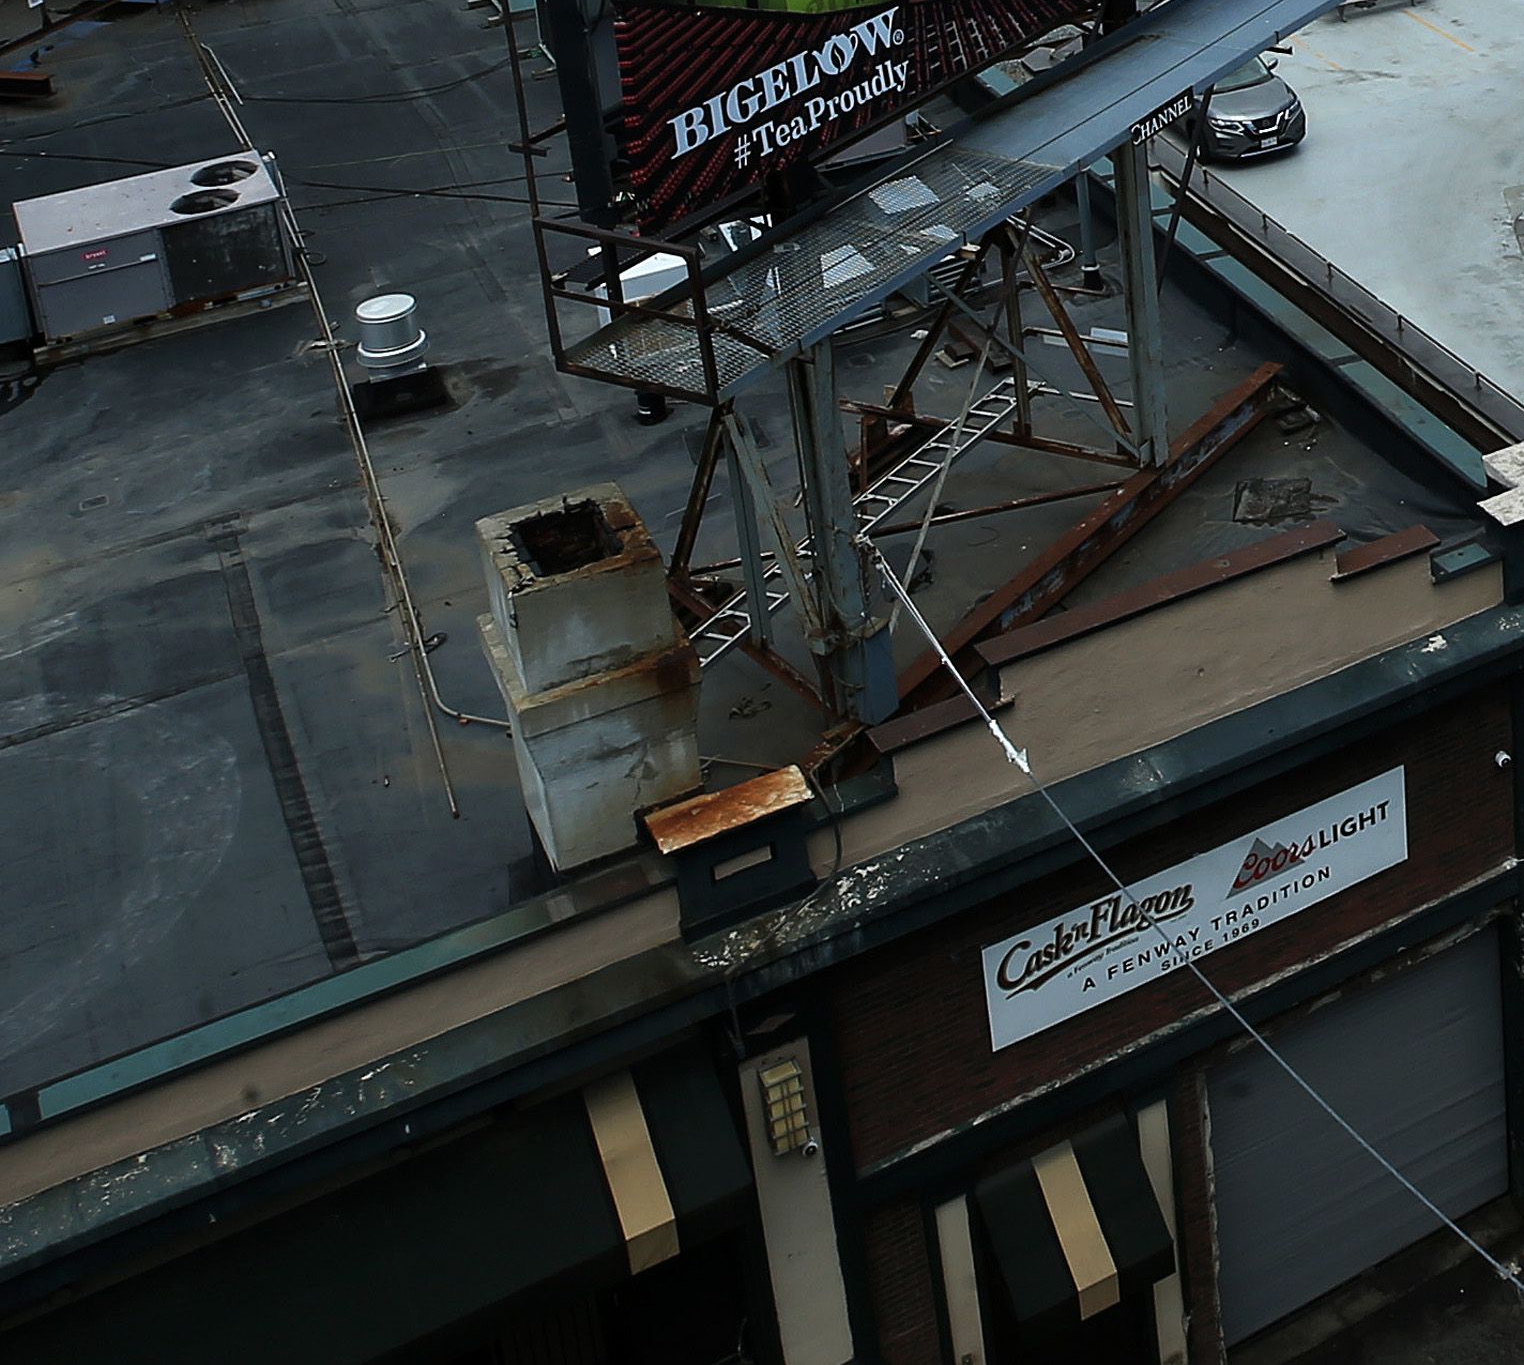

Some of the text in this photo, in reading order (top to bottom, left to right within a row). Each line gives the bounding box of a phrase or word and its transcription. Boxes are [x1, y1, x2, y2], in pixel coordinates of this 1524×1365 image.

[666, 6, 900, 160] BIGELOW
[733, 60, 910, 170] #TeaProudly
[1130, 95, 1193, 146] CHANNEL
[1232, 799, 1392, 890] Coors LIGHT
[1082, 865, 1332, 993] A FENWAY TRADITION
[1085, 882, 1196, 946] Flagon
[1160, 917, 1261, 972] SINCE 1969
